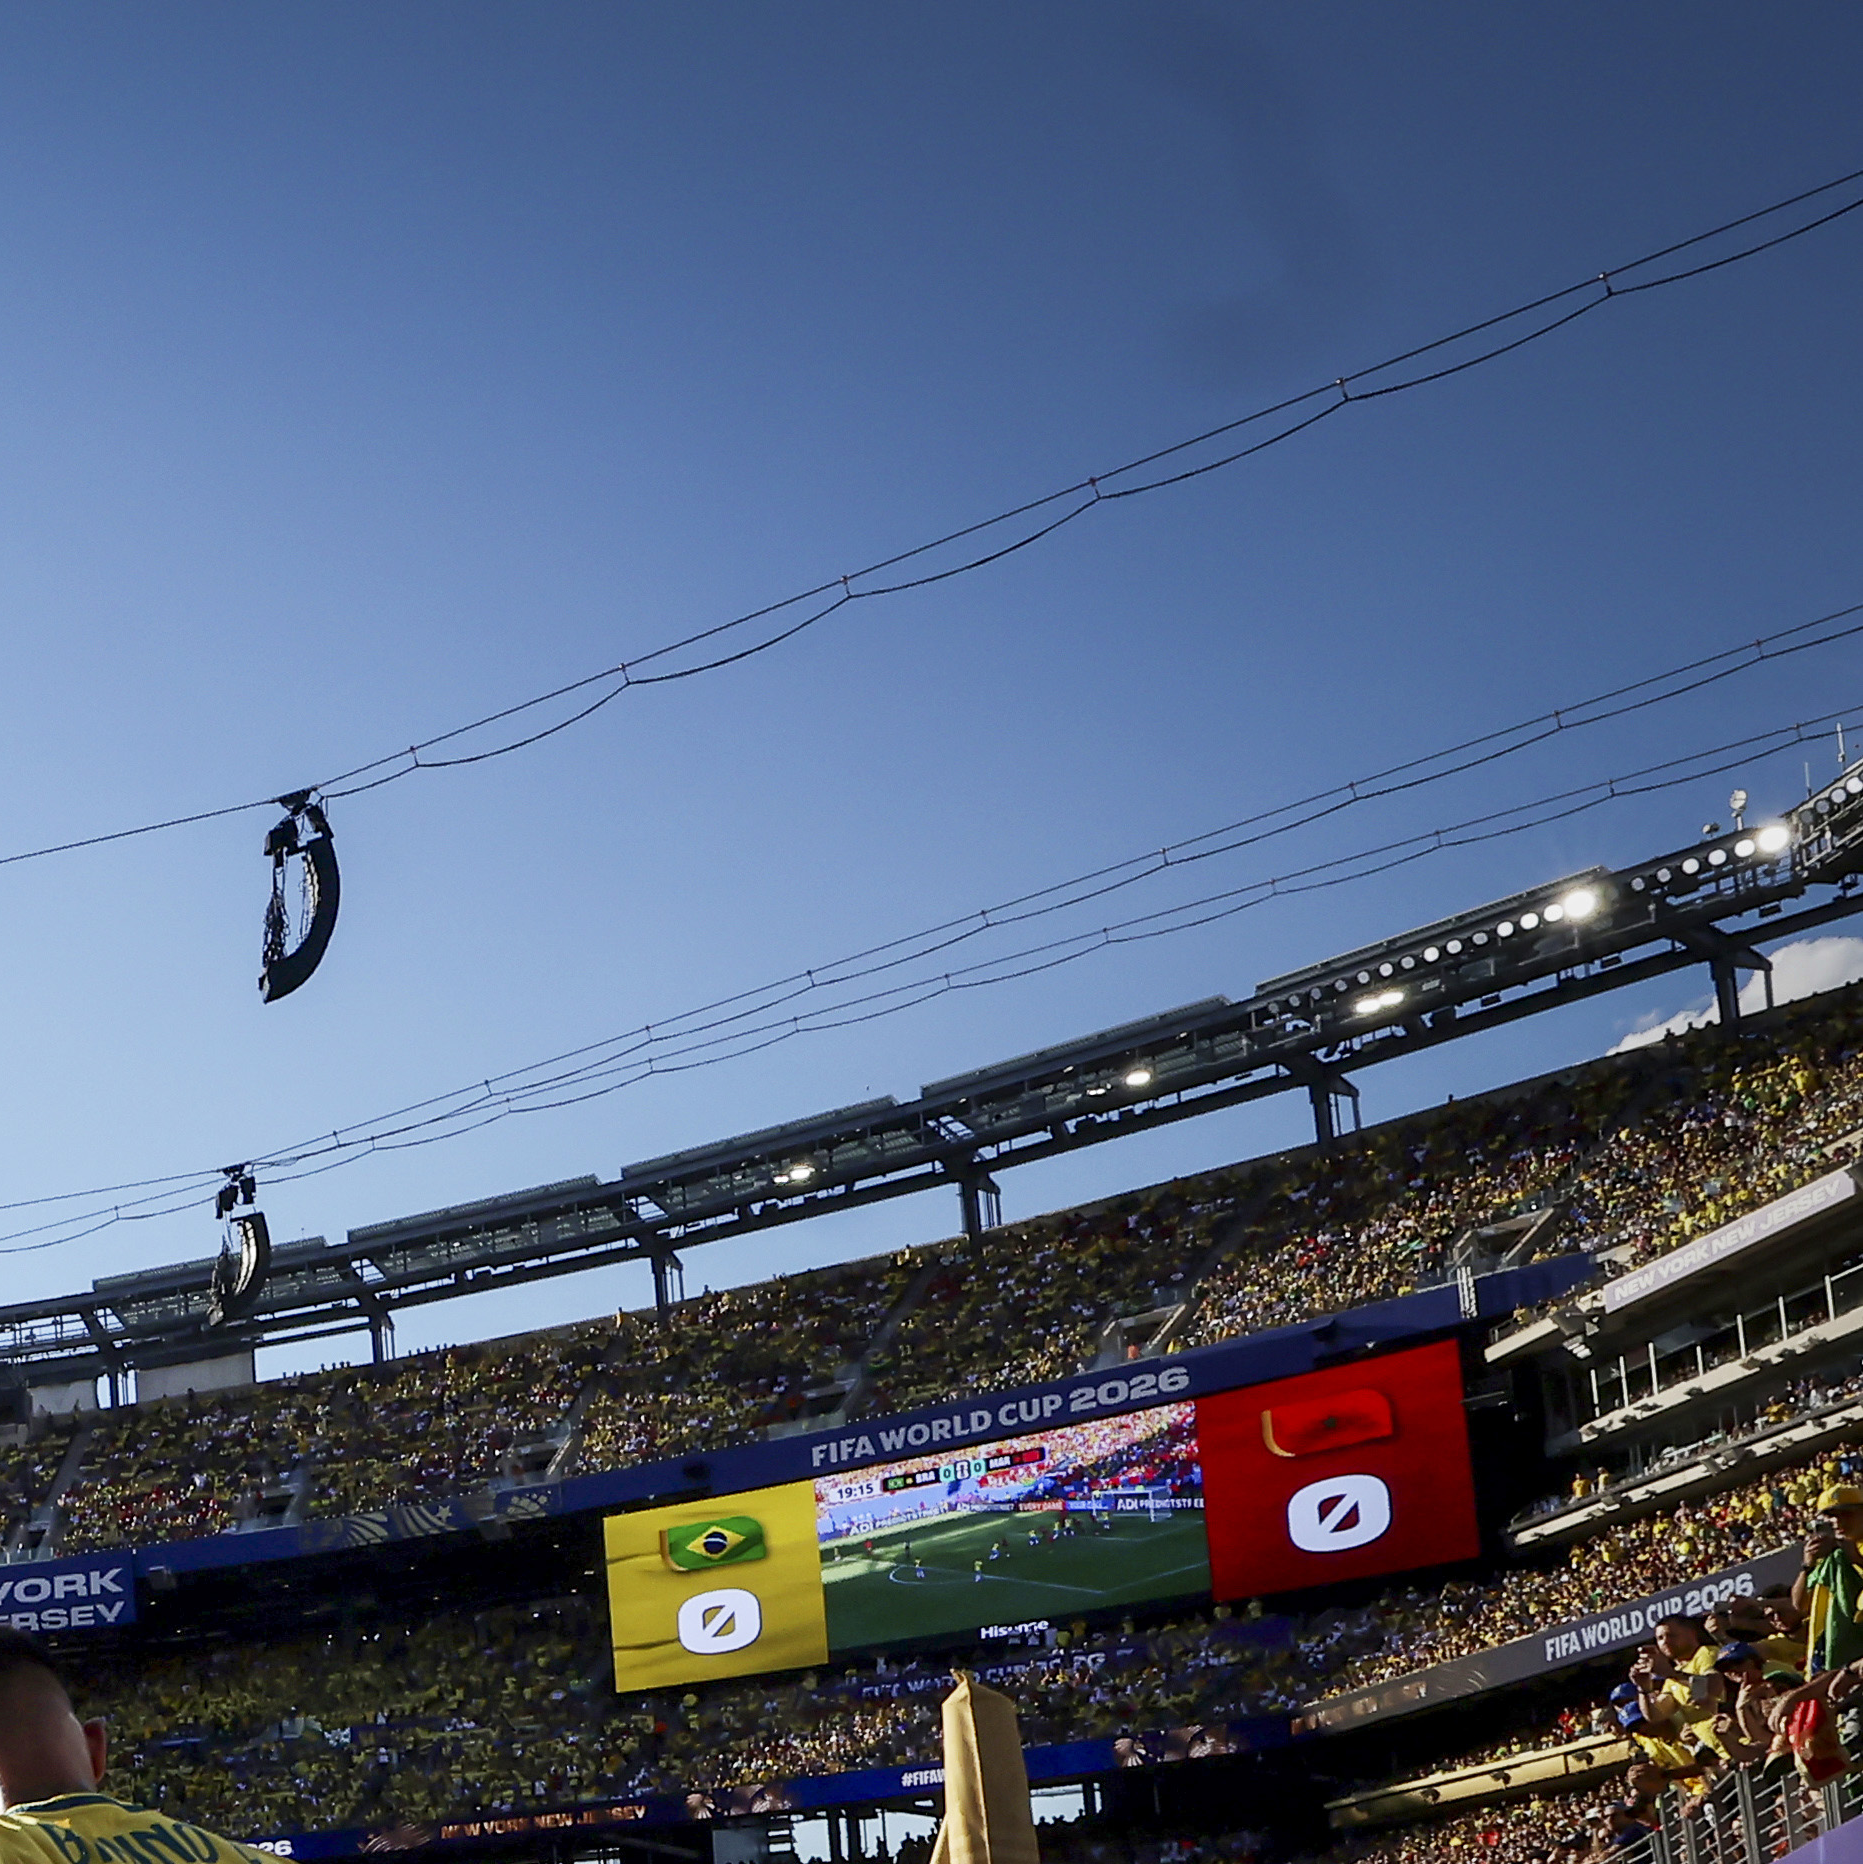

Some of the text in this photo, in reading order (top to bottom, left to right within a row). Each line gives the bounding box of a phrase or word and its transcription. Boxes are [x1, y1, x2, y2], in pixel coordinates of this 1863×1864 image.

[811, 1366, 1191, 1468] FIFA WORLD CUP 2026
[837, 1485, 874, 1499] 19:15
[1287, 1473, 1392, 1553] 0
[677, 1587, 762, 1655] 0
[1545, 1633, 1581, 1662] FIFA
[1581, 1610, 1645, 1650] WORLD
[1684, 1572, 1754, 1617] 2026
